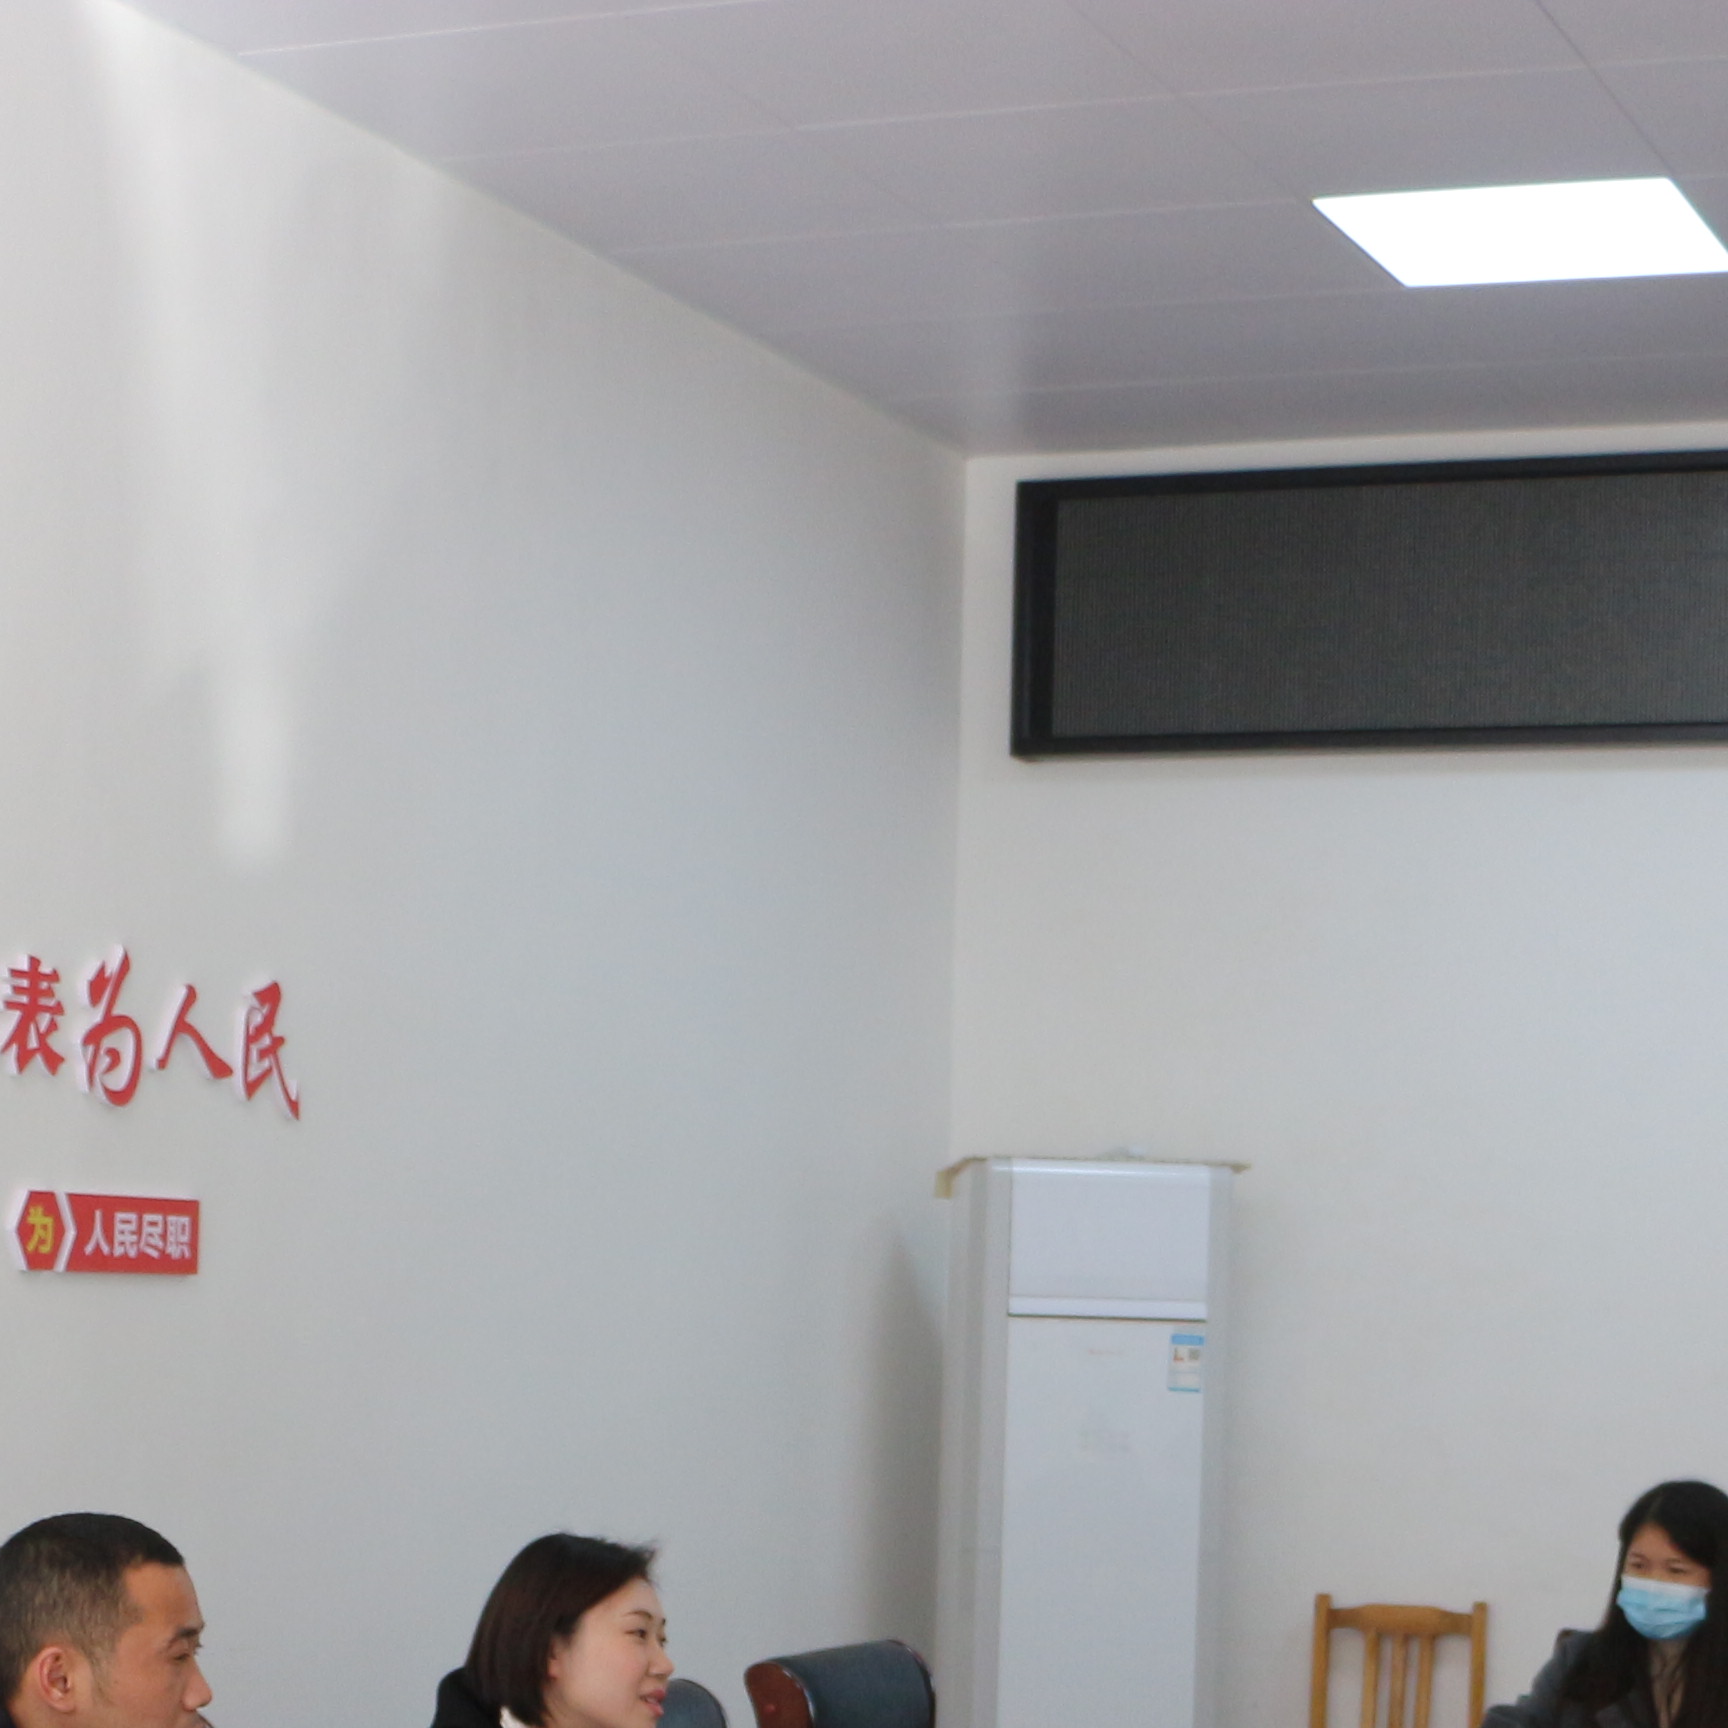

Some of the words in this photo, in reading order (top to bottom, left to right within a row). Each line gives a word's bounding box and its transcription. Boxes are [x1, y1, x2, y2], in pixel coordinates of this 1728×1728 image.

[27, 1206, 54, 1254] 为
[84, 1210, 191, 1259] 人民尽职
